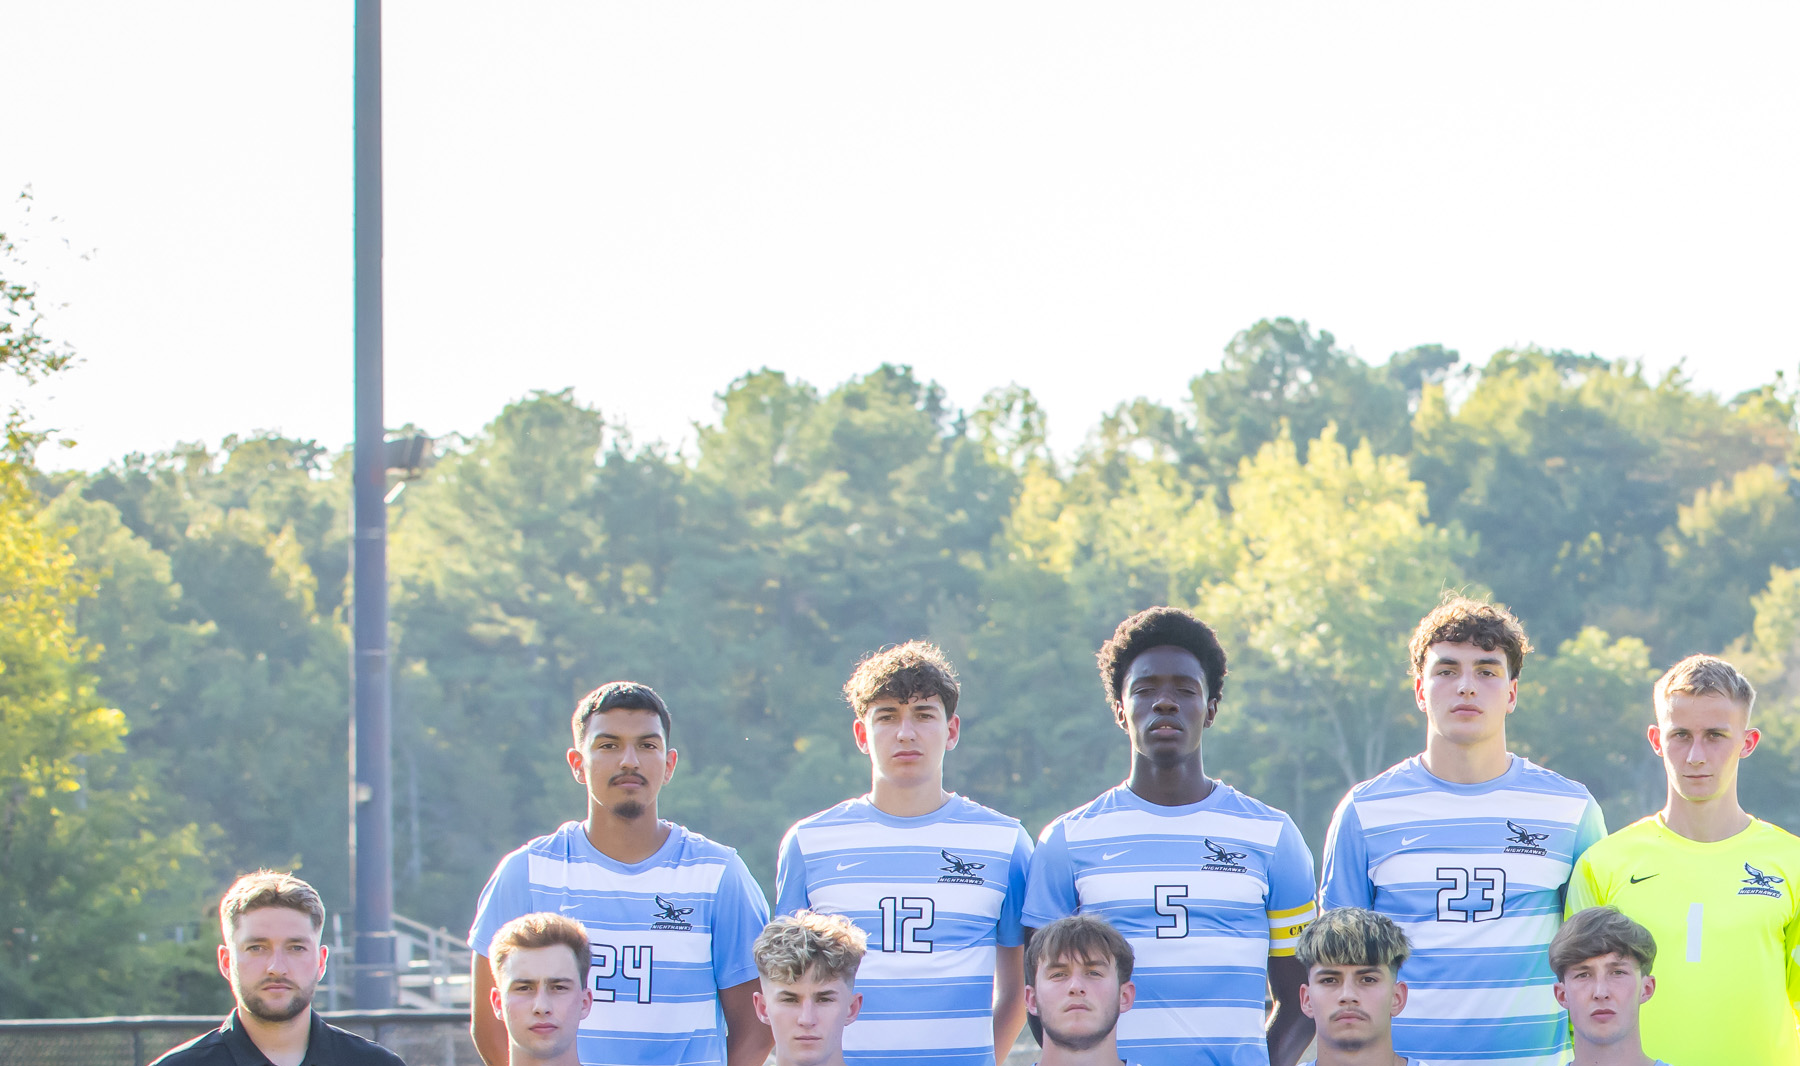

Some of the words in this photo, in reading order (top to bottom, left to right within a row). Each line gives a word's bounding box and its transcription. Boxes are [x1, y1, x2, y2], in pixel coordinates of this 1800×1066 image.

[1504, 847, 1547, 856] NIGHTHAWKS
[938, 876, 985, 885] NIGHTHAWKS
[1202, 865, 1247, 873] NIGHTHAWKS
[1435, 867, 1507, 923] 23
[1738, 887, 1781, 898] NIGHTHAWKS
[651, 923, 692, 931] NIGHTHAWKS
[879, 896, 935, 953] 12
[1154, 885, 1190, 940] 5
[1686, 902, 1704, 963] 1
[590, 945, 654, 1004] 24
